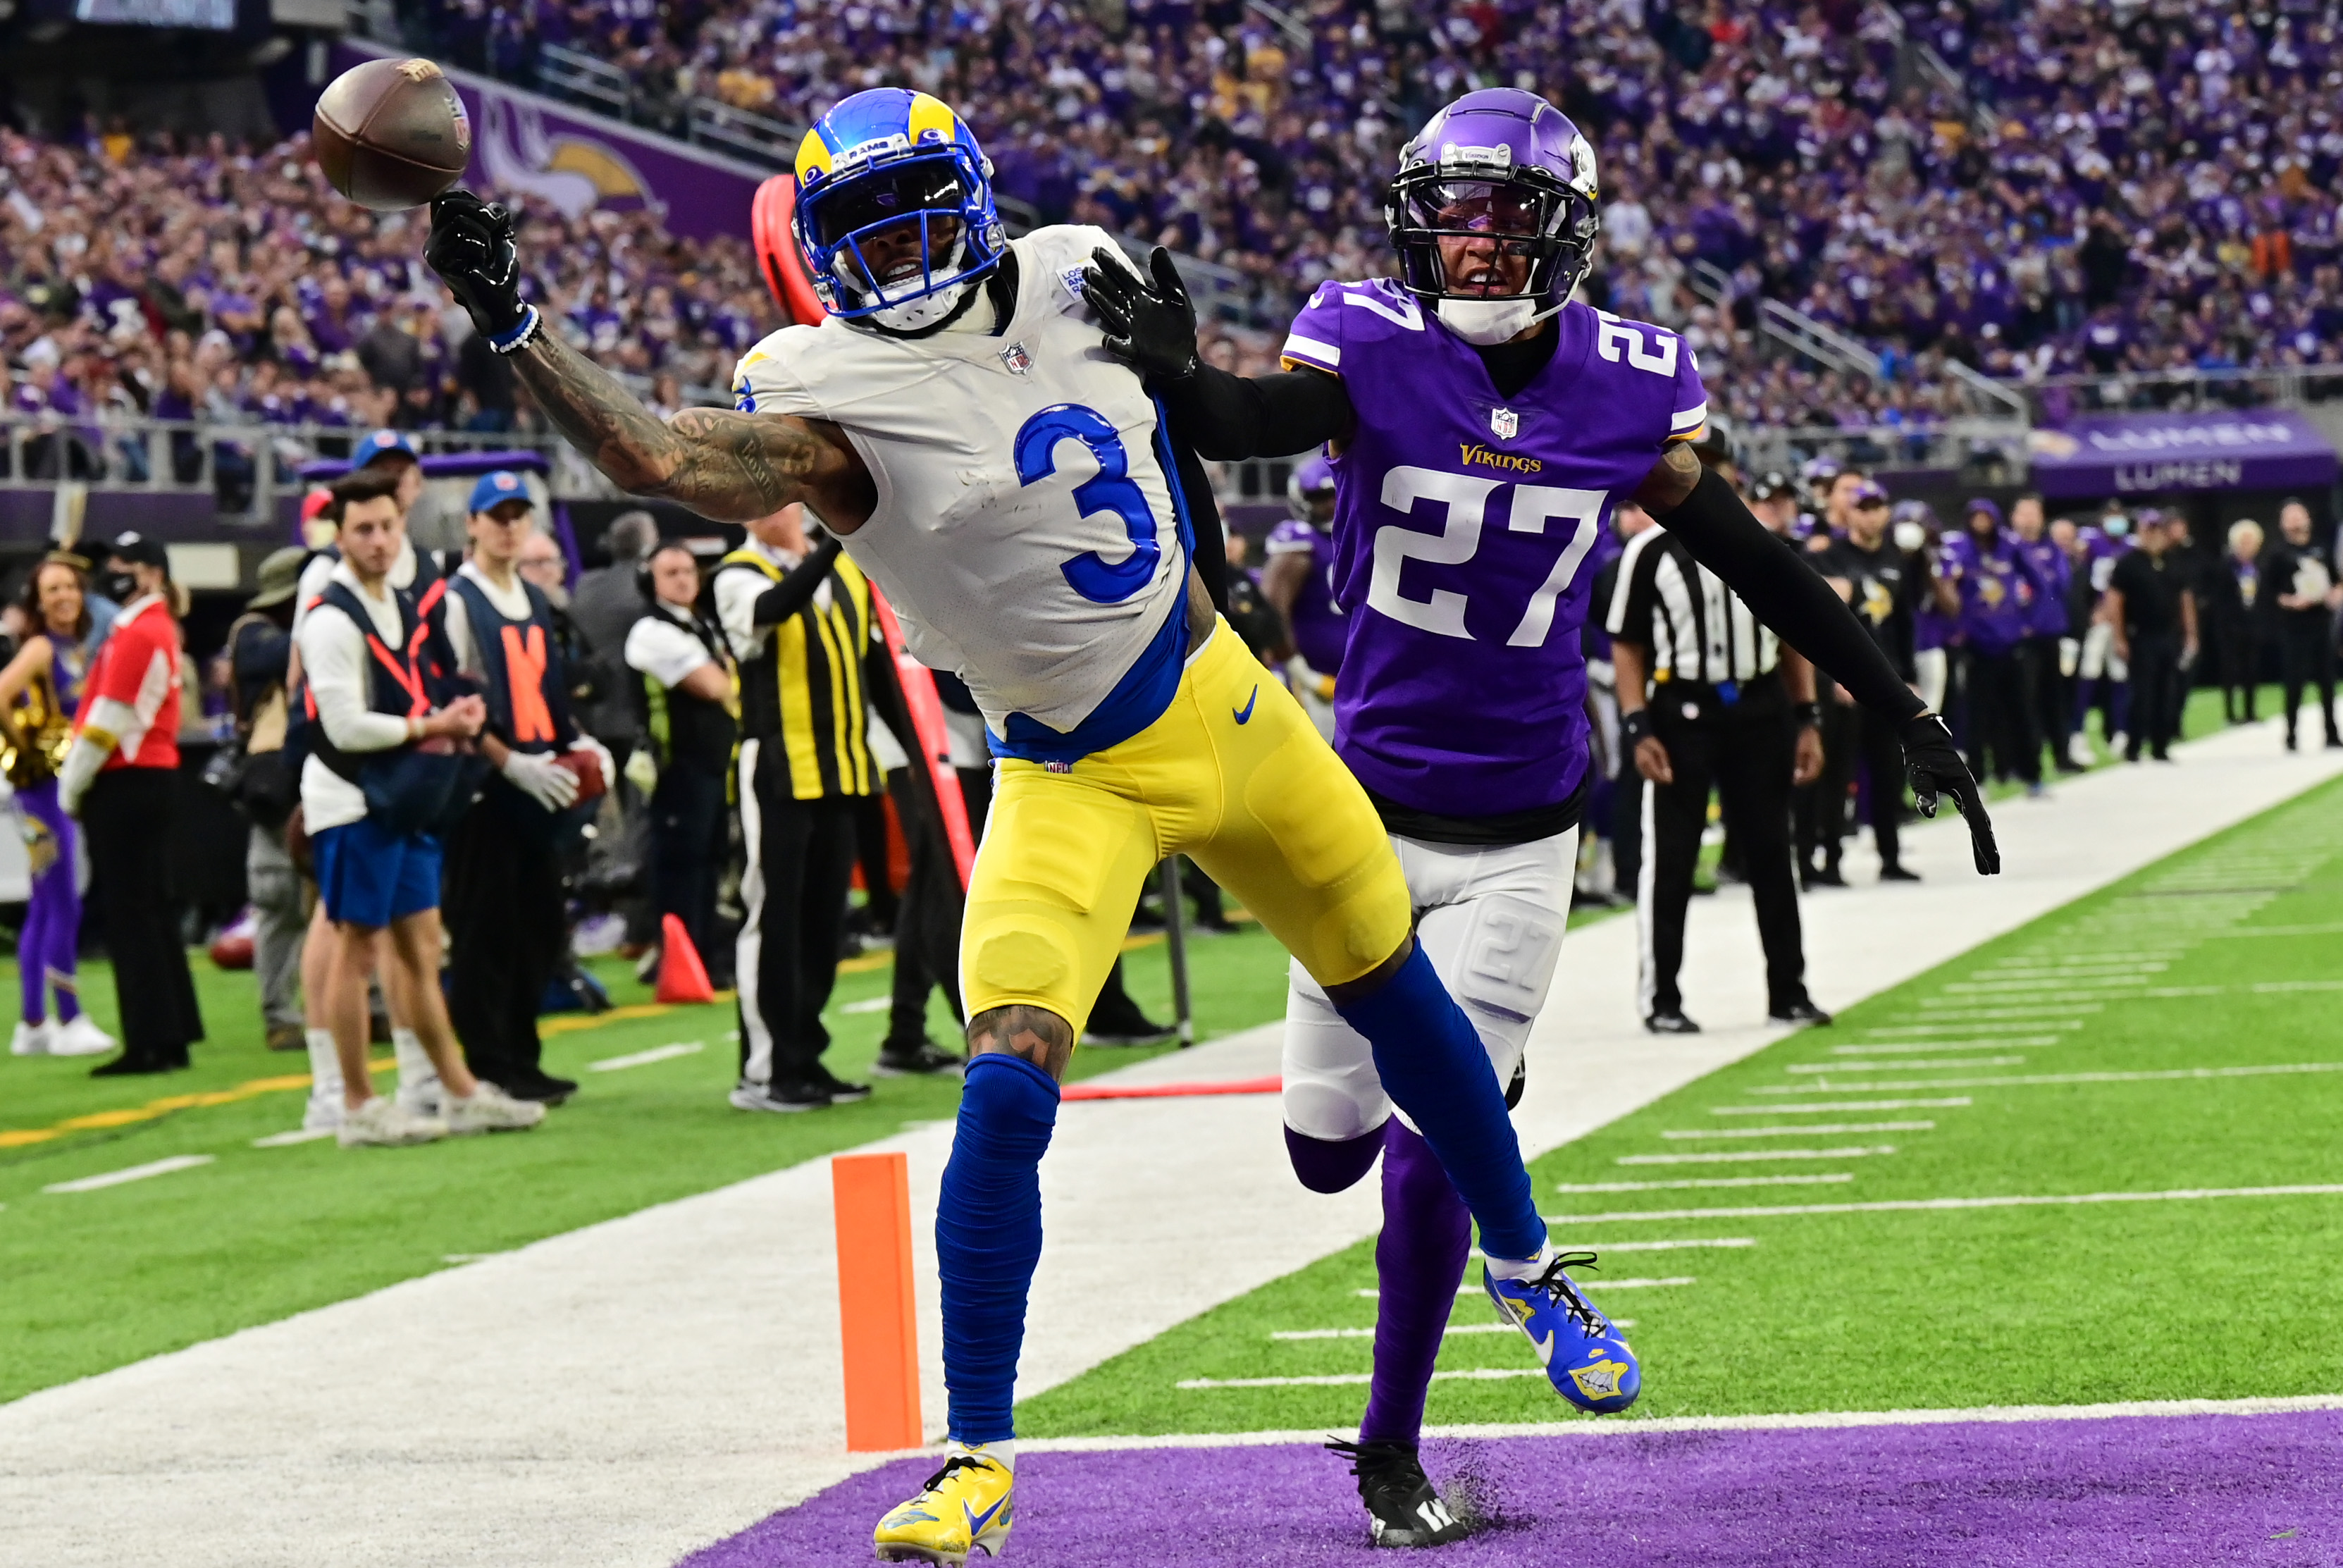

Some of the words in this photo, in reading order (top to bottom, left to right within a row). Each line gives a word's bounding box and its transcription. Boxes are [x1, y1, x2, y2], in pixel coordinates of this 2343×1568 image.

[848, 141, 889, 160] RAMS
[2088, 424, 2292, 452] LUMEN
[1013, 402, 1161, 603] 3
[2114, 457, 2242, 492] LUMEN
[1366, 465, 1609, 647] 27
[1471, 910, 1559, 993] 27
